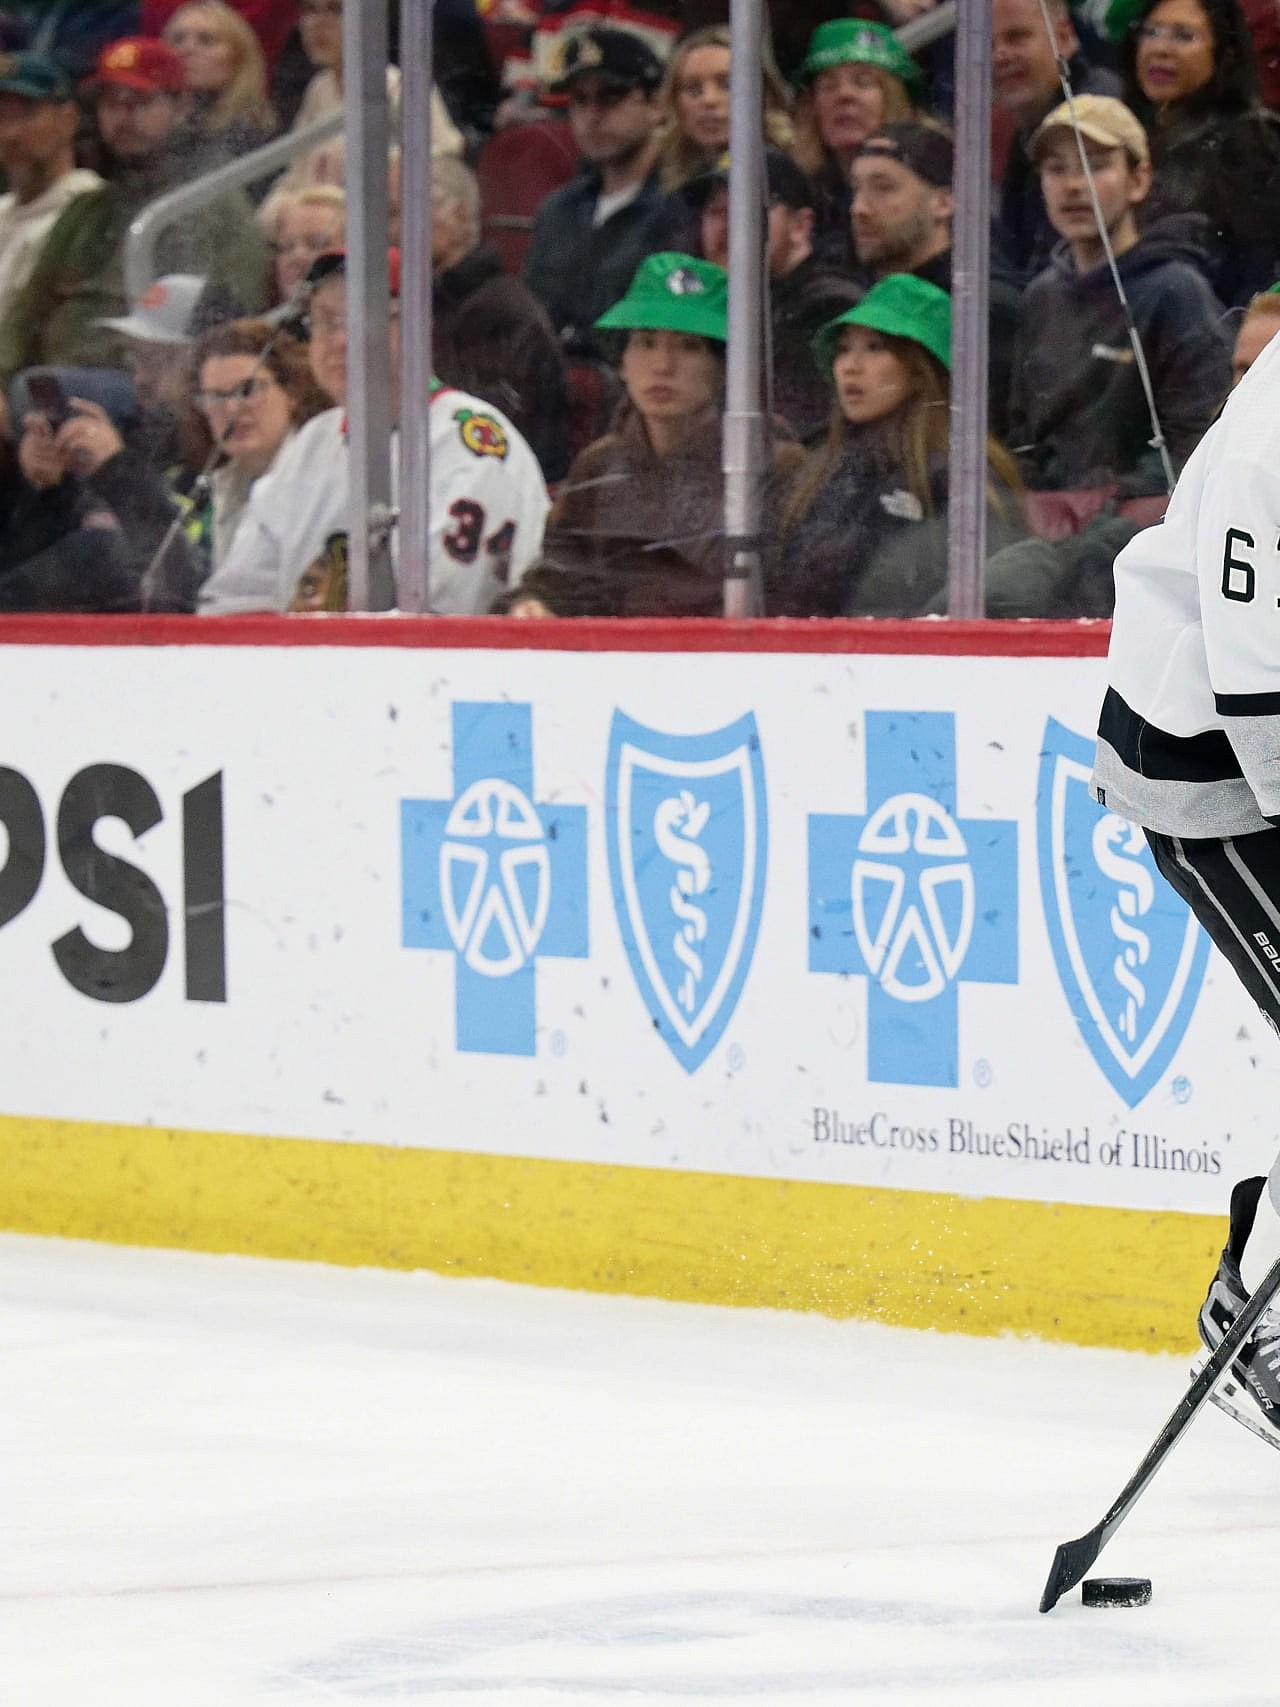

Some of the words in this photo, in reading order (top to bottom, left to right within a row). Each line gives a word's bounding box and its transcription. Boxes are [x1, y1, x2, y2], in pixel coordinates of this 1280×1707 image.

[813, 1106, 939, 1152] BlueCross
[948, 1117, 1090, 1165] BlueShield
[1099, 1129, 1126, 1166] of
[1132, 1133, 1222, 1175] Illinois
